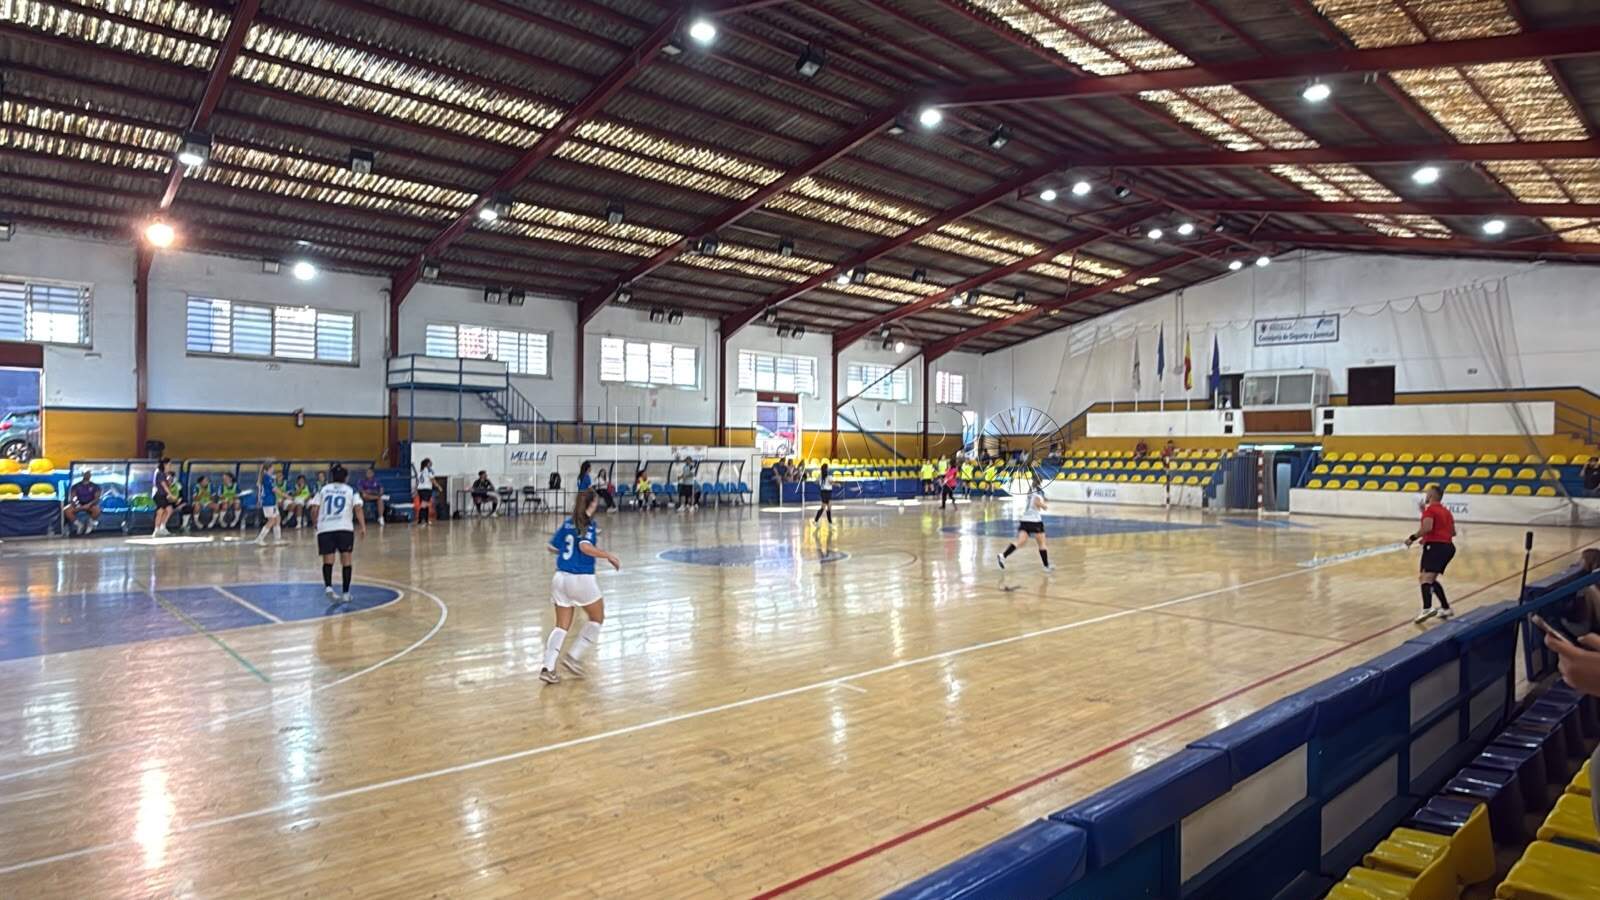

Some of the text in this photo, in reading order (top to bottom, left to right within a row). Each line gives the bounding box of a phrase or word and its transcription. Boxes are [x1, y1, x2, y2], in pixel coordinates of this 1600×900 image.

[511, 449, 548, 462] MELILLA
[324, 494, 347, 516] 19
[562, 534, 575, 561] 3
